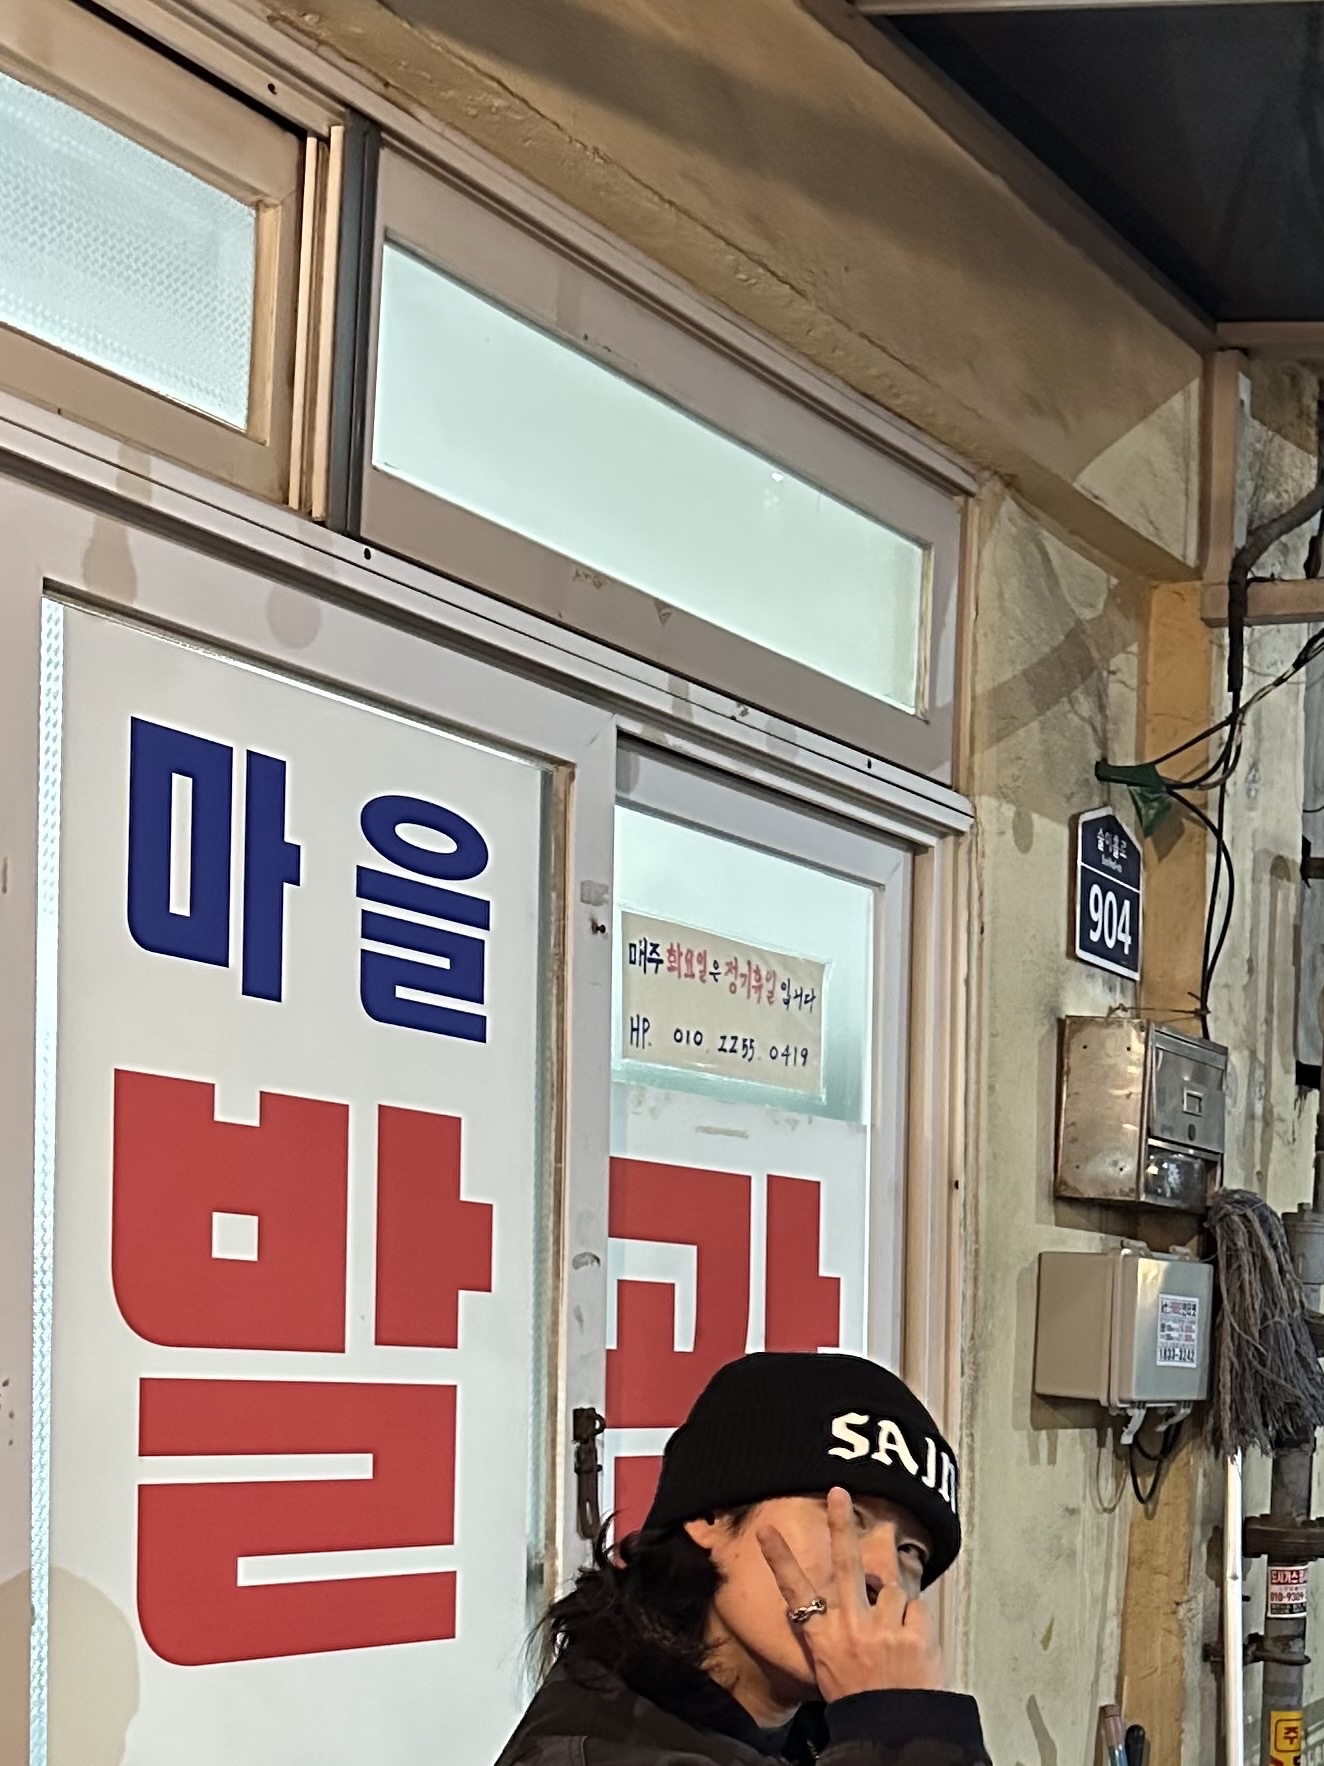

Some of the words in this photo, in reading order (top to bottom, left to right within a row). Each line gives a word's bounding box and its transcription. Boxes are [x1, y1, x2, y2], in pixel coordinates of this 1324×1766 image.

[127, 714, 491, 1044] 마을
[1088, 883, 1132, 955] 904
[628, 937, 664, 974] 매주
[666, 942, 722, 984] 화요일은
[780, 977, 816, 1012] 입니다
[768, 1044, 810, 1068] 0419
[111, 1066, 493, 1668] 발
